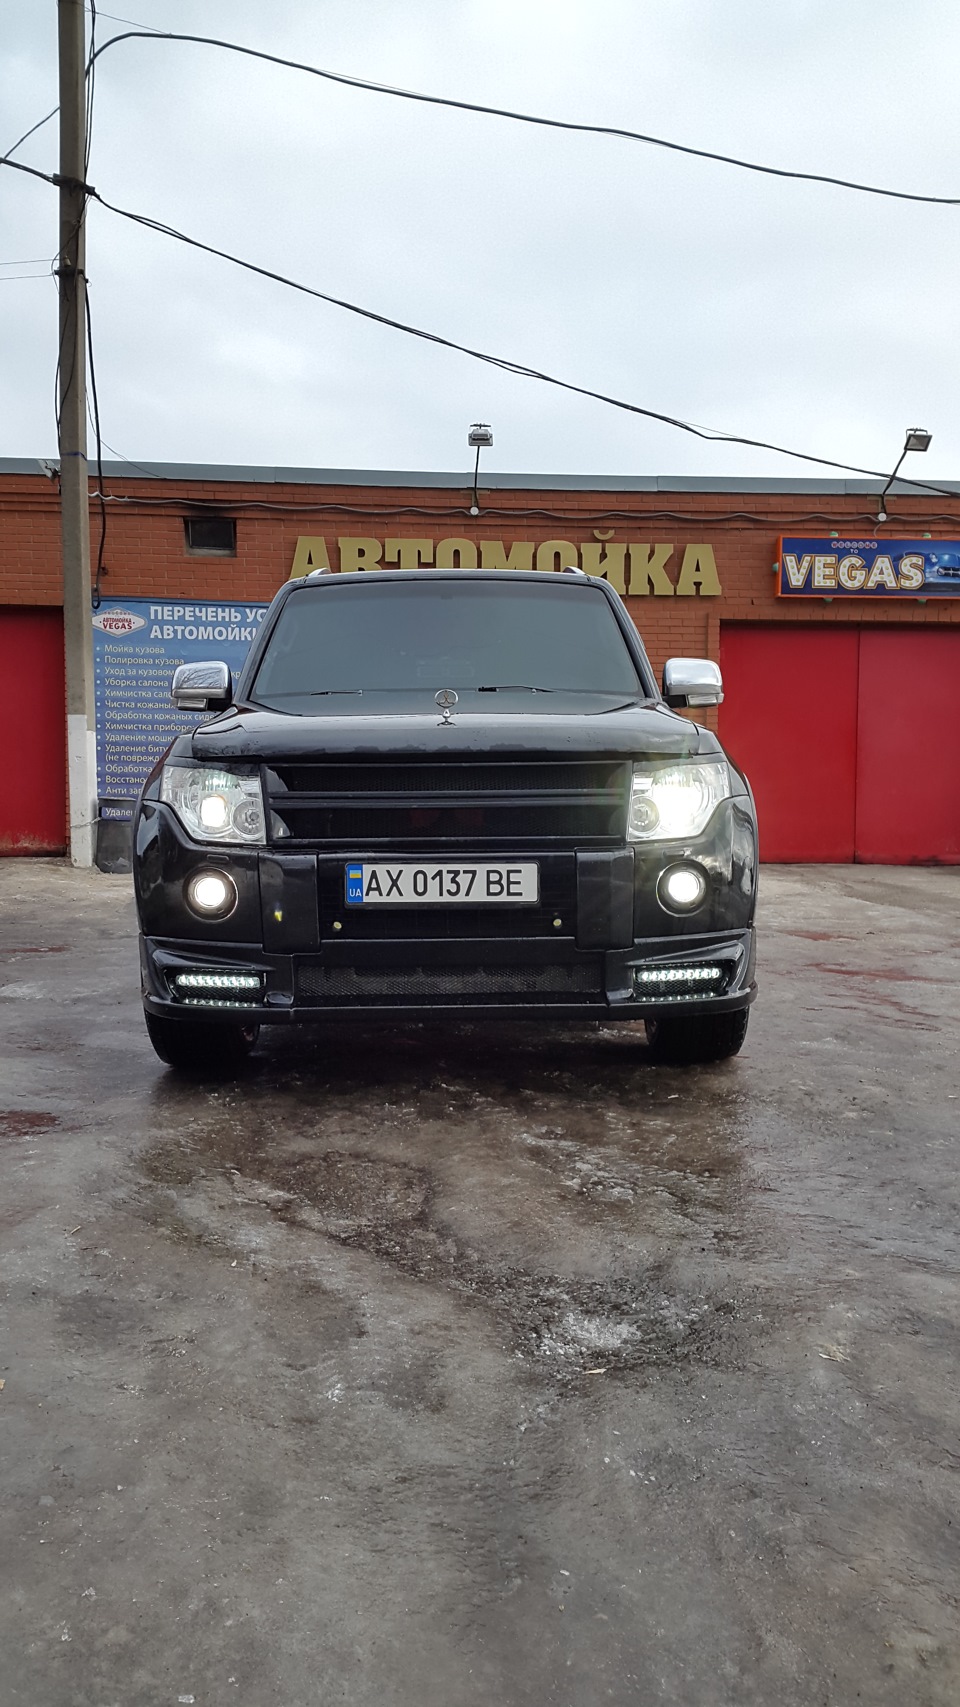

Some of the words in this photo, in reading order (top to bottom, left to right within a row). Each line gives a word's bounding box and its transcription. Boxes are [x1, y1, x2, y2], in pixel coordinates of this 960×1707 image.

[288, 530, 722, 596] АВТОМОЙКА
[783, 554, 925, 590] VEGAS
[150, 606, 241, 622] ПЕРЕЧЕНЬ
[104, 644, 133, 653] Мойка
[135, 647, 165, 655] кузова
[104, 656, 153, 666] Полировка
[155, 659, 185, 667] кузова
[104, 667, 126, 677] Уход
[138, 669, 174, 678] кузовом
[104, 678, 136, 688] Уборка
[104, 689, 152, 698] Химчистка
[105, 700, 135, 709] Чистка
[105, 711, 152, 721] Обработка
[105, 722, 152, 731] Химчистка
[105, 733, 147, 743] Удаление
[105, 744, 147, 754] Удаление
[105, 754, 119, 762] (не
[105, 764, 153, 774] Обработка
[105, 786, 127, 794] Анти
[365, 869, 404, 897] AX
[413, 869, 478, 897] 0137
[486, 869, 523, 897] BE
[350, 888, 362, 897] UA
